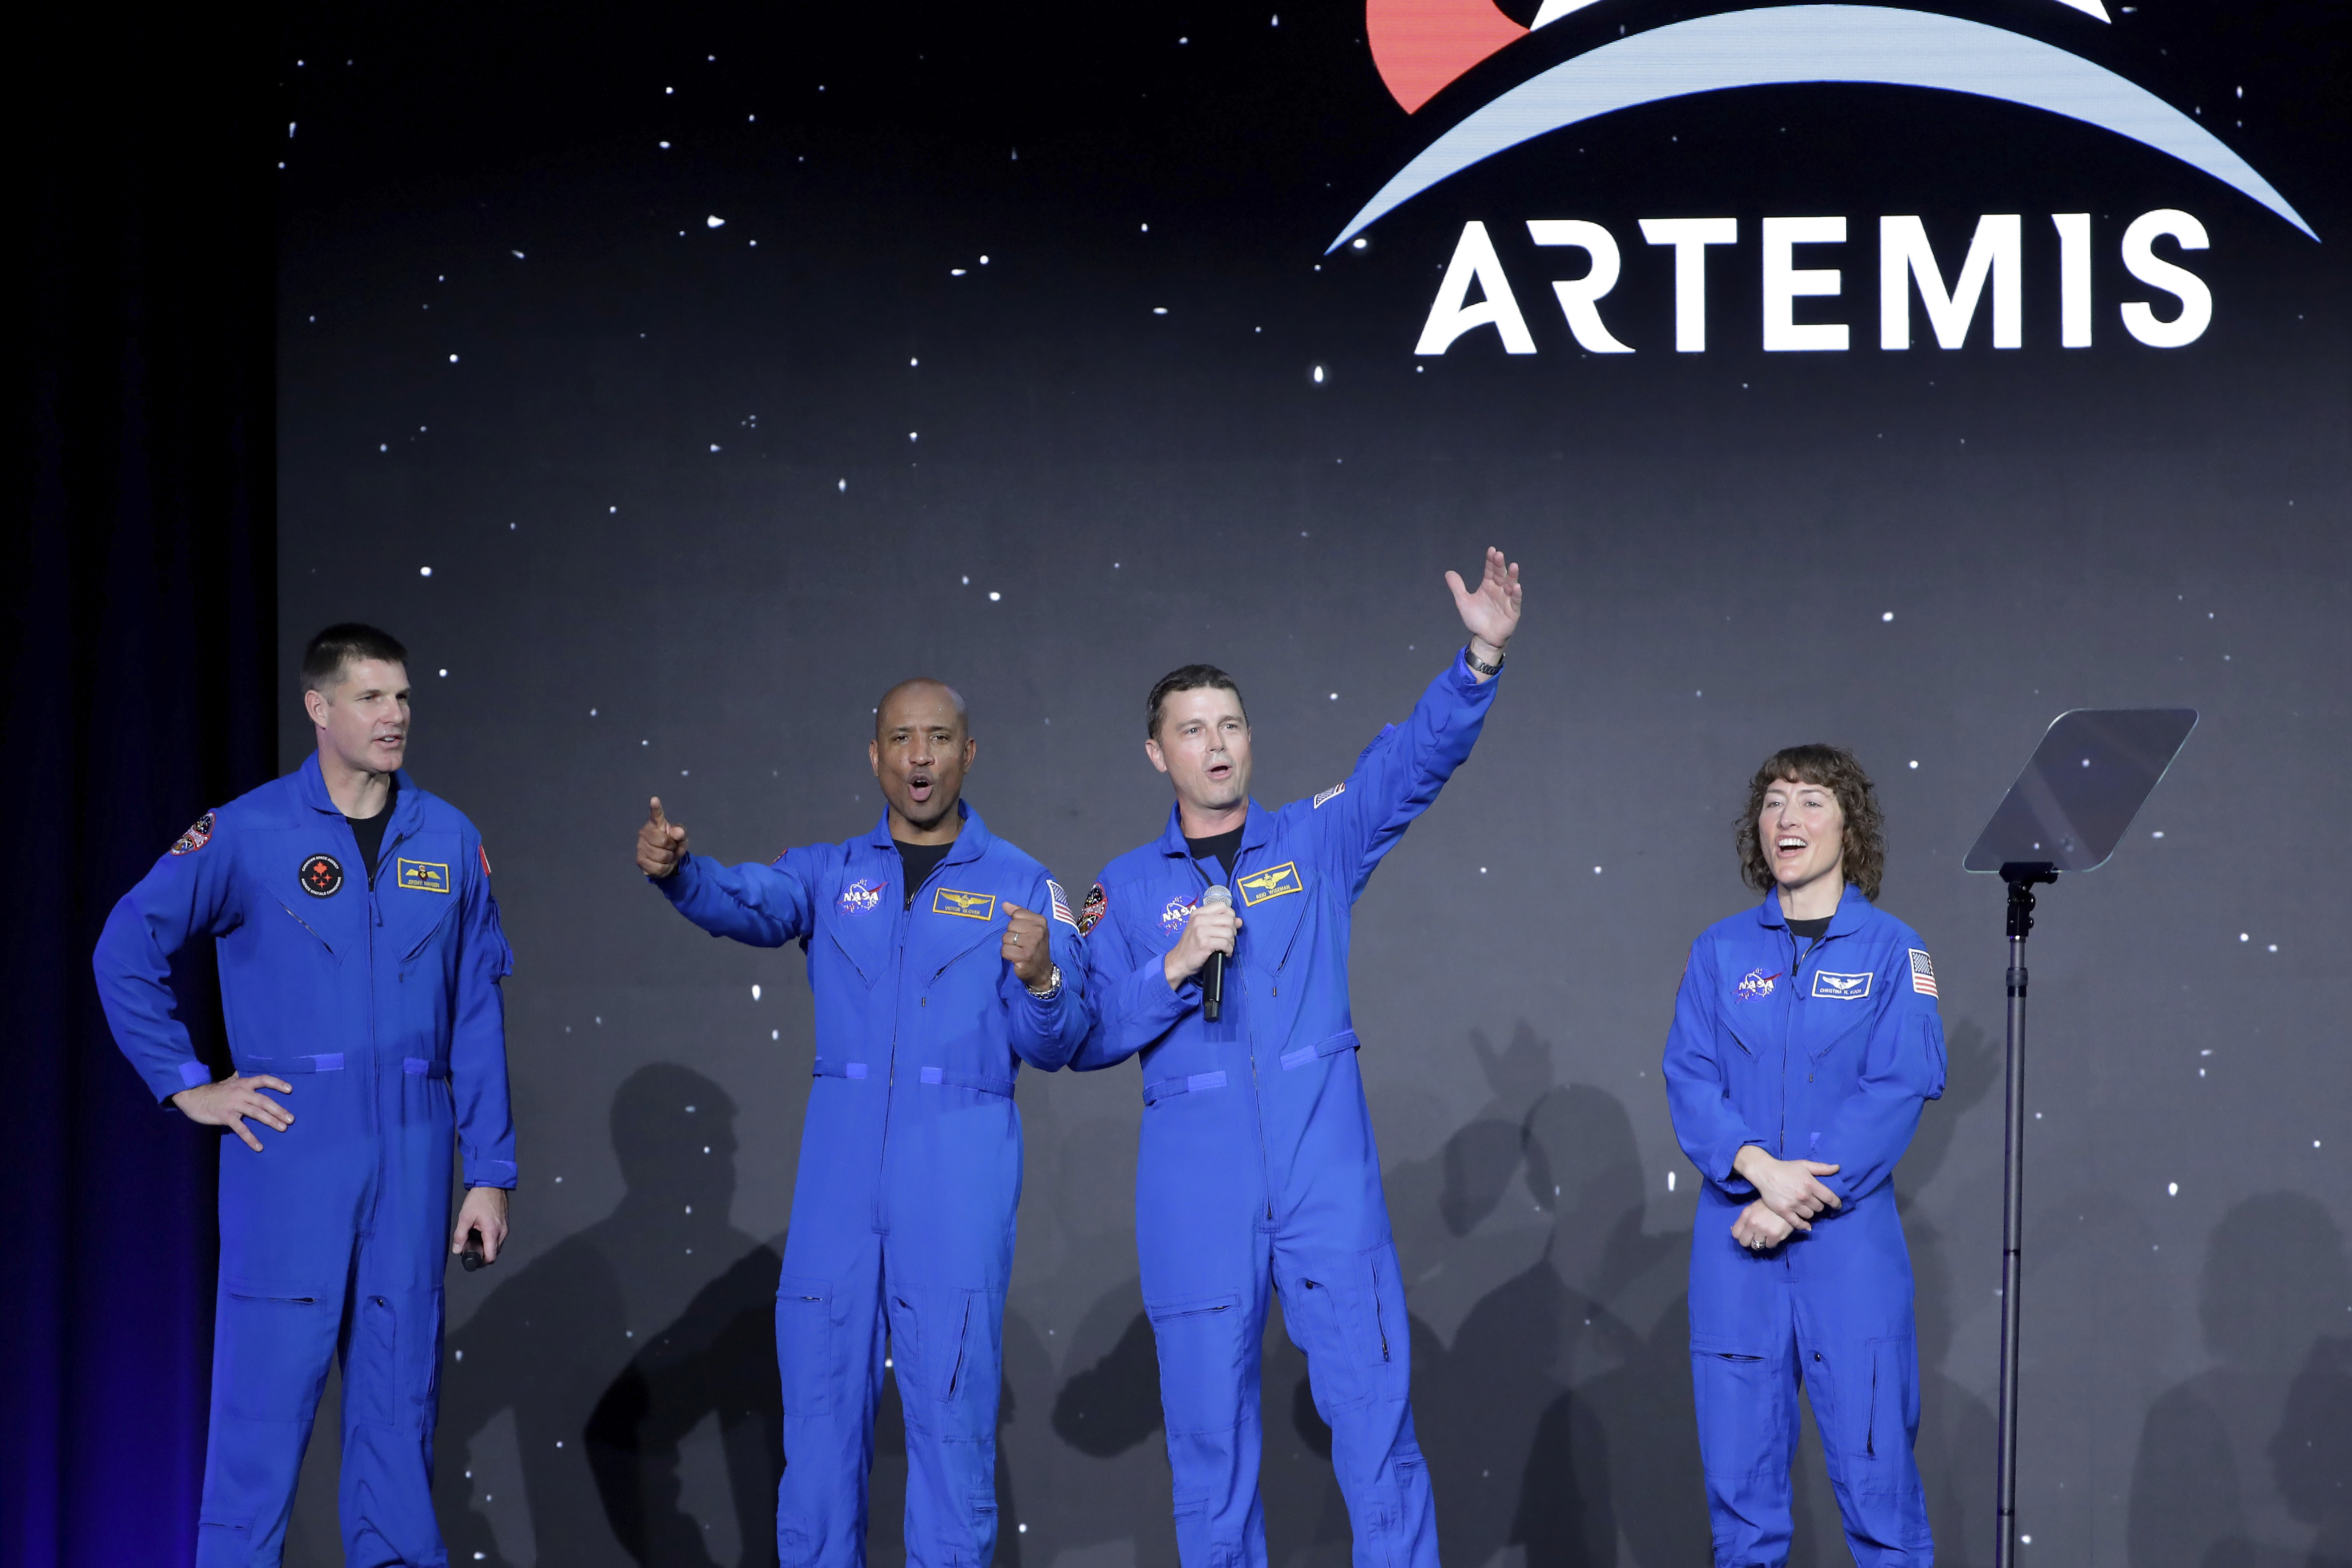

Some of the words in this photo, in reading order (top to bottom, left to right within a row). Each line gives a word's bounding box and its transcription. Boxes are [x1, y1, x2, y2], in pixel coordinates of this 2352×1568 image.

[1414, 208, 2213, 355] ARTEMIS
[1268, 884, 1291, 894] WISEMAN
[844, 891, 879, 902] NASA
[1739, 980, 1775, 990] NASA
